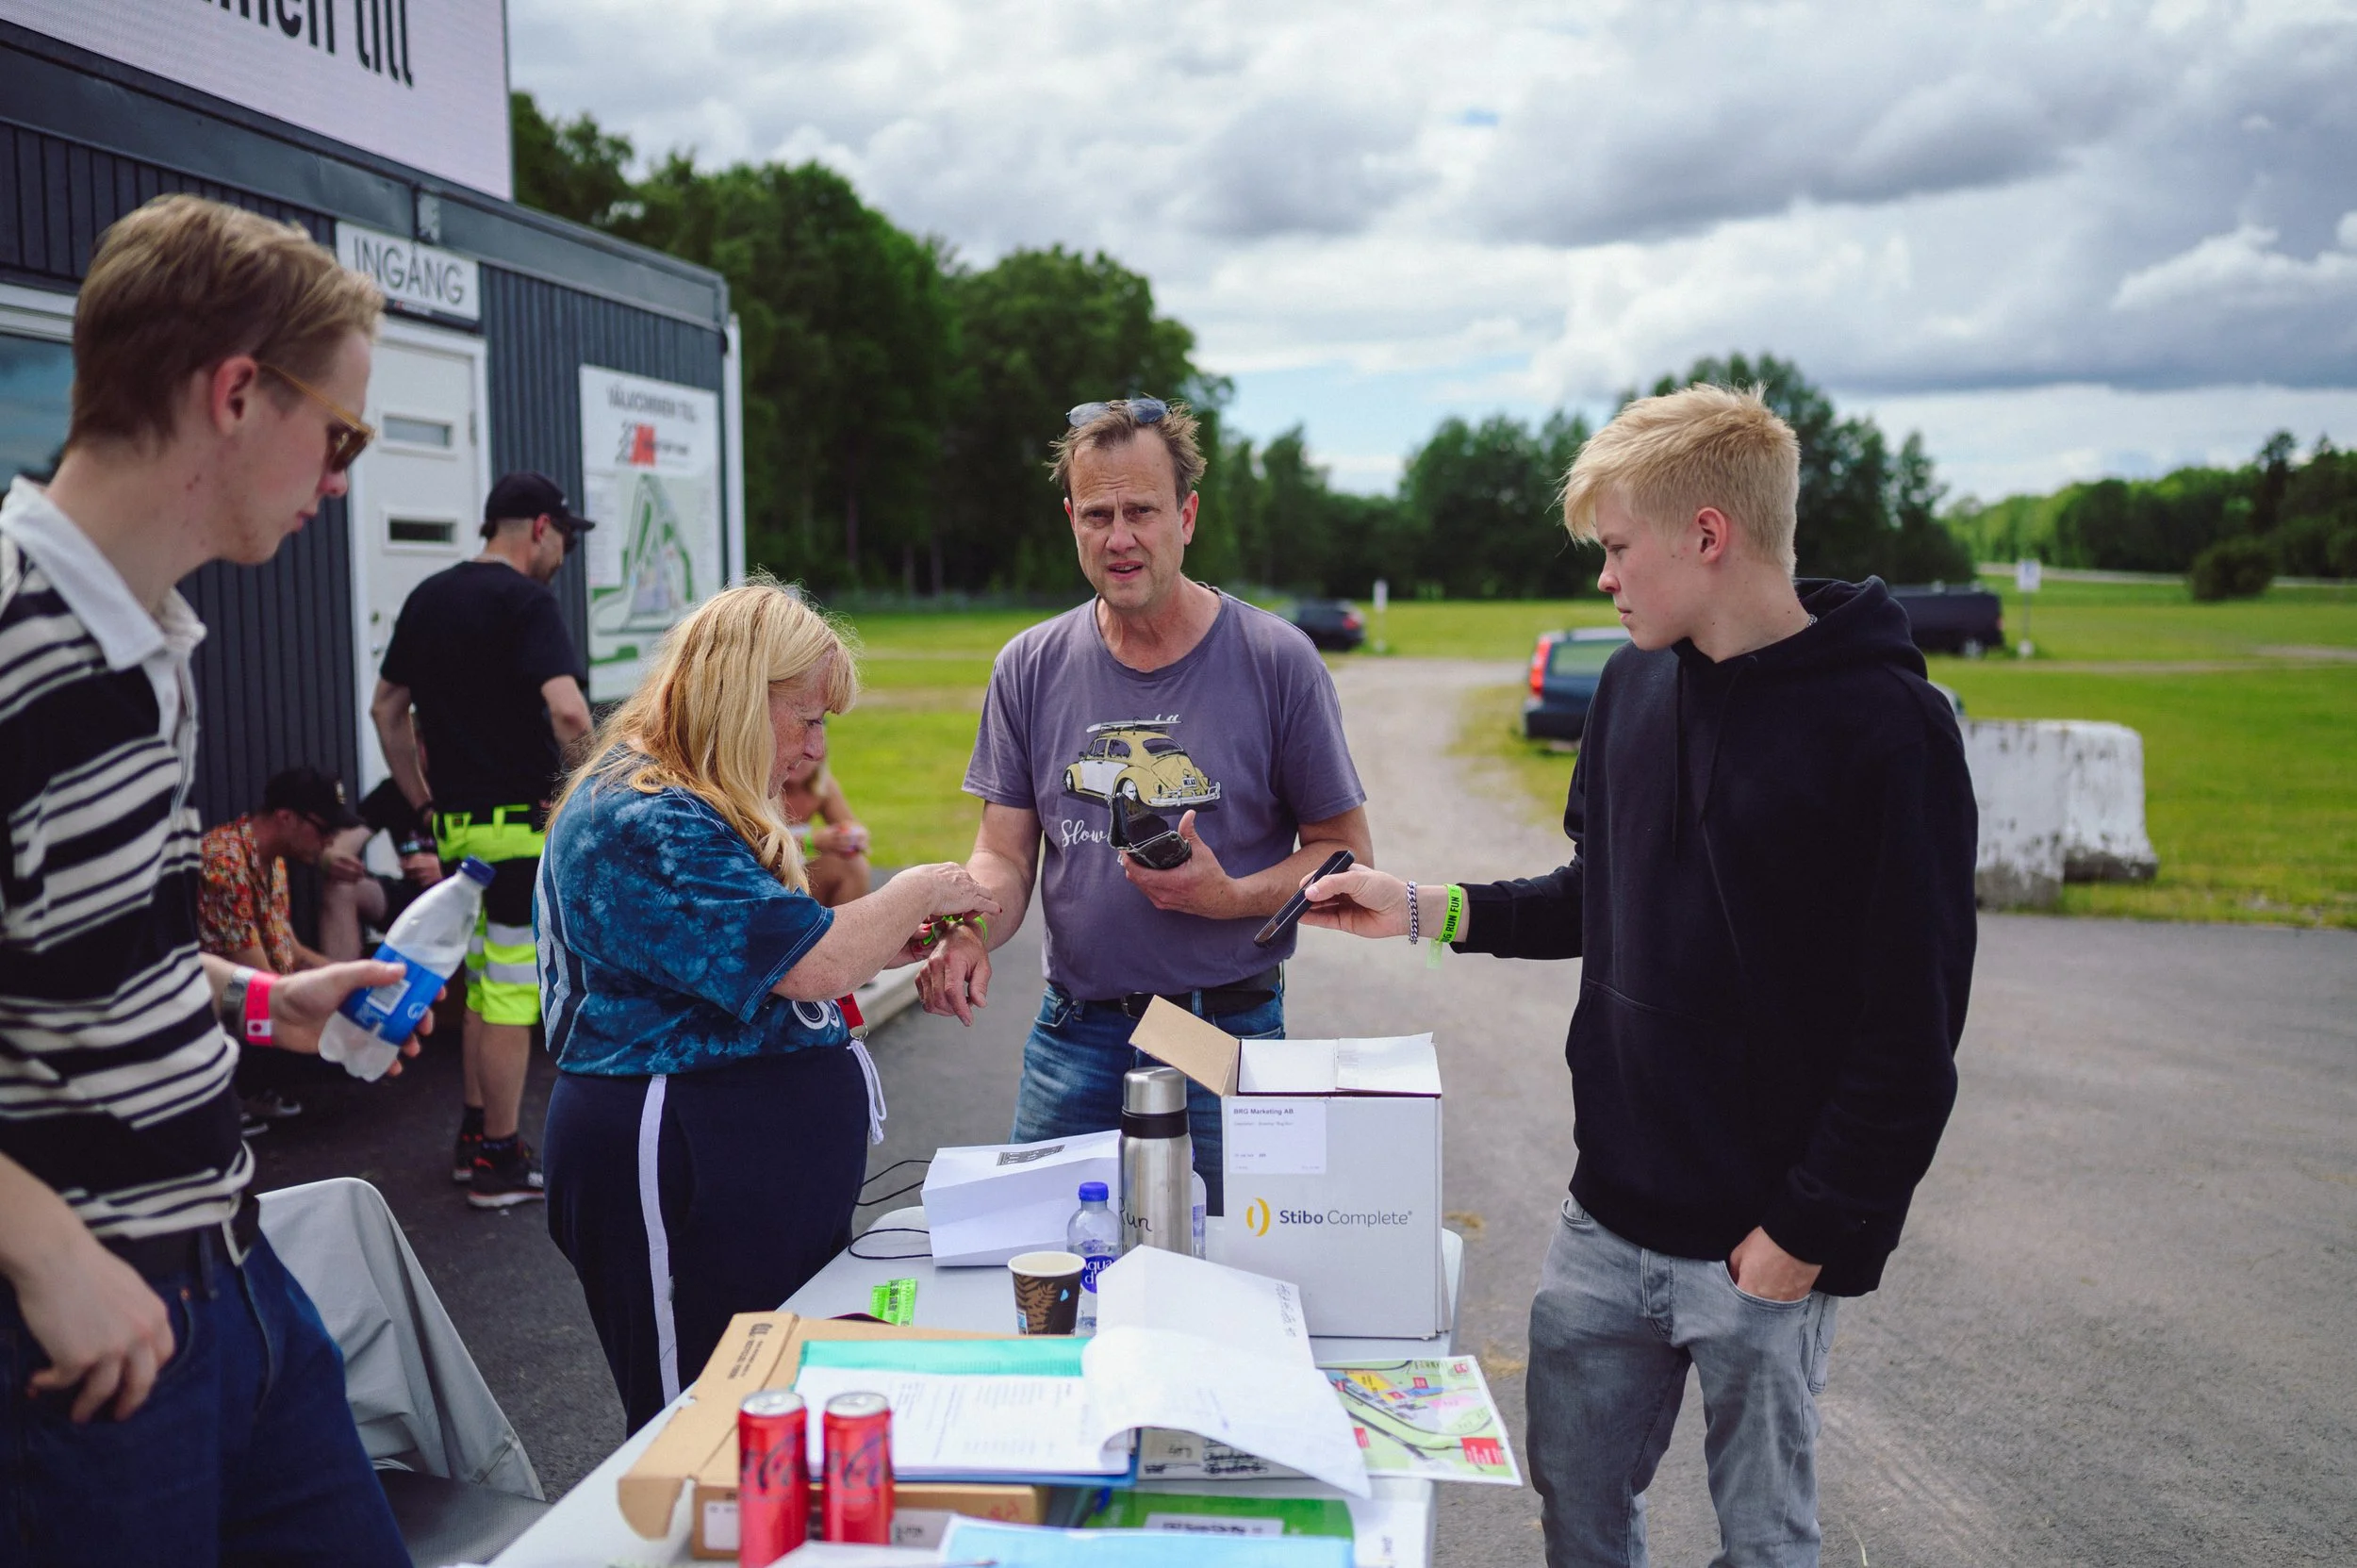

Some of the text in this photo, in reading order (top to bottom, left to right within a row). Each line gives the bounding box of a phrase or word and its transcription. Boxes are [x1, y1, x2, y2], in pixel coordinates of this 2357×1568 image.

[353, 237, 465, 305] INGÅNG
[1450, 896, 1459, 913] FUN
[1445, 915, 1457, 932] RUN
[1250, 1108, 1282, 1116] Marketing
[1279, 1210, 1324, 1225] Stibo
